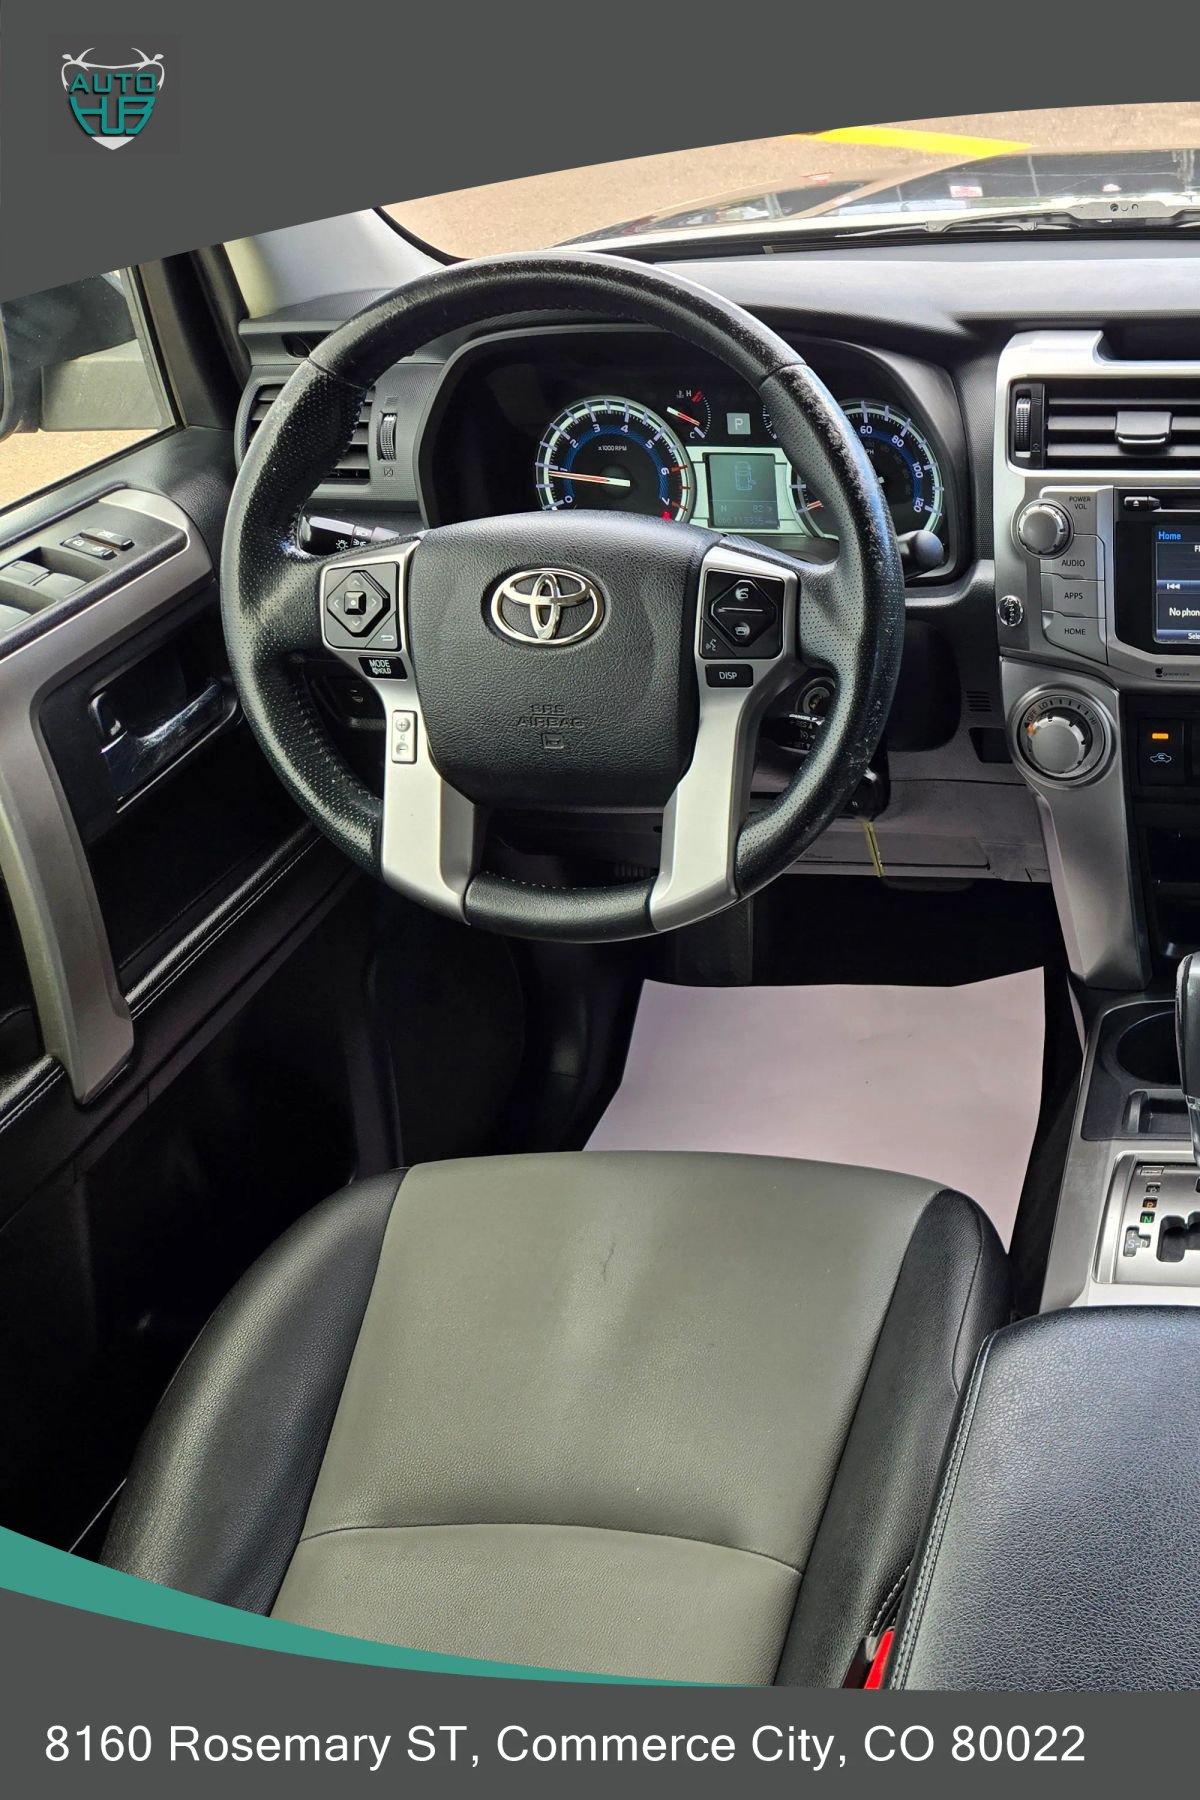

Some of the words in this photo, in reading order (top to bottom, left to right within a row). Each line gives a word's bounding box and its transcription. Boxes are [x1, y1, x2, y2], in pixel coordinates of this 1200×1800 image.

[593, 424, 601, 433] 3
[734, 418, 743, 430] P
[620, 425, 629, 433] 4
[860, 425, 873, 434] 60
[569, 439, 579, 449] 2
[645, 440, 655, 449] 5
[891, 435, 904, 448] 80
[660, 467, 670, 475] 6
[912, 461, 924, 478] 100
[564, 495, 573, 503] 0
[661, 497, 670, 505] 7
[913, 497, 924, 513] 120
[1158, 531, 1181, 540] Home
[1061, 559, 1085, 567] AUDIO
[1064, 592, 1083, 600] APPS
[1169, 608, 1181, 616] No
[1064, 628, 1086, 636] HOME
[369, 659, 390, 668] MODE
[719, 672, 737, 680] DISP
